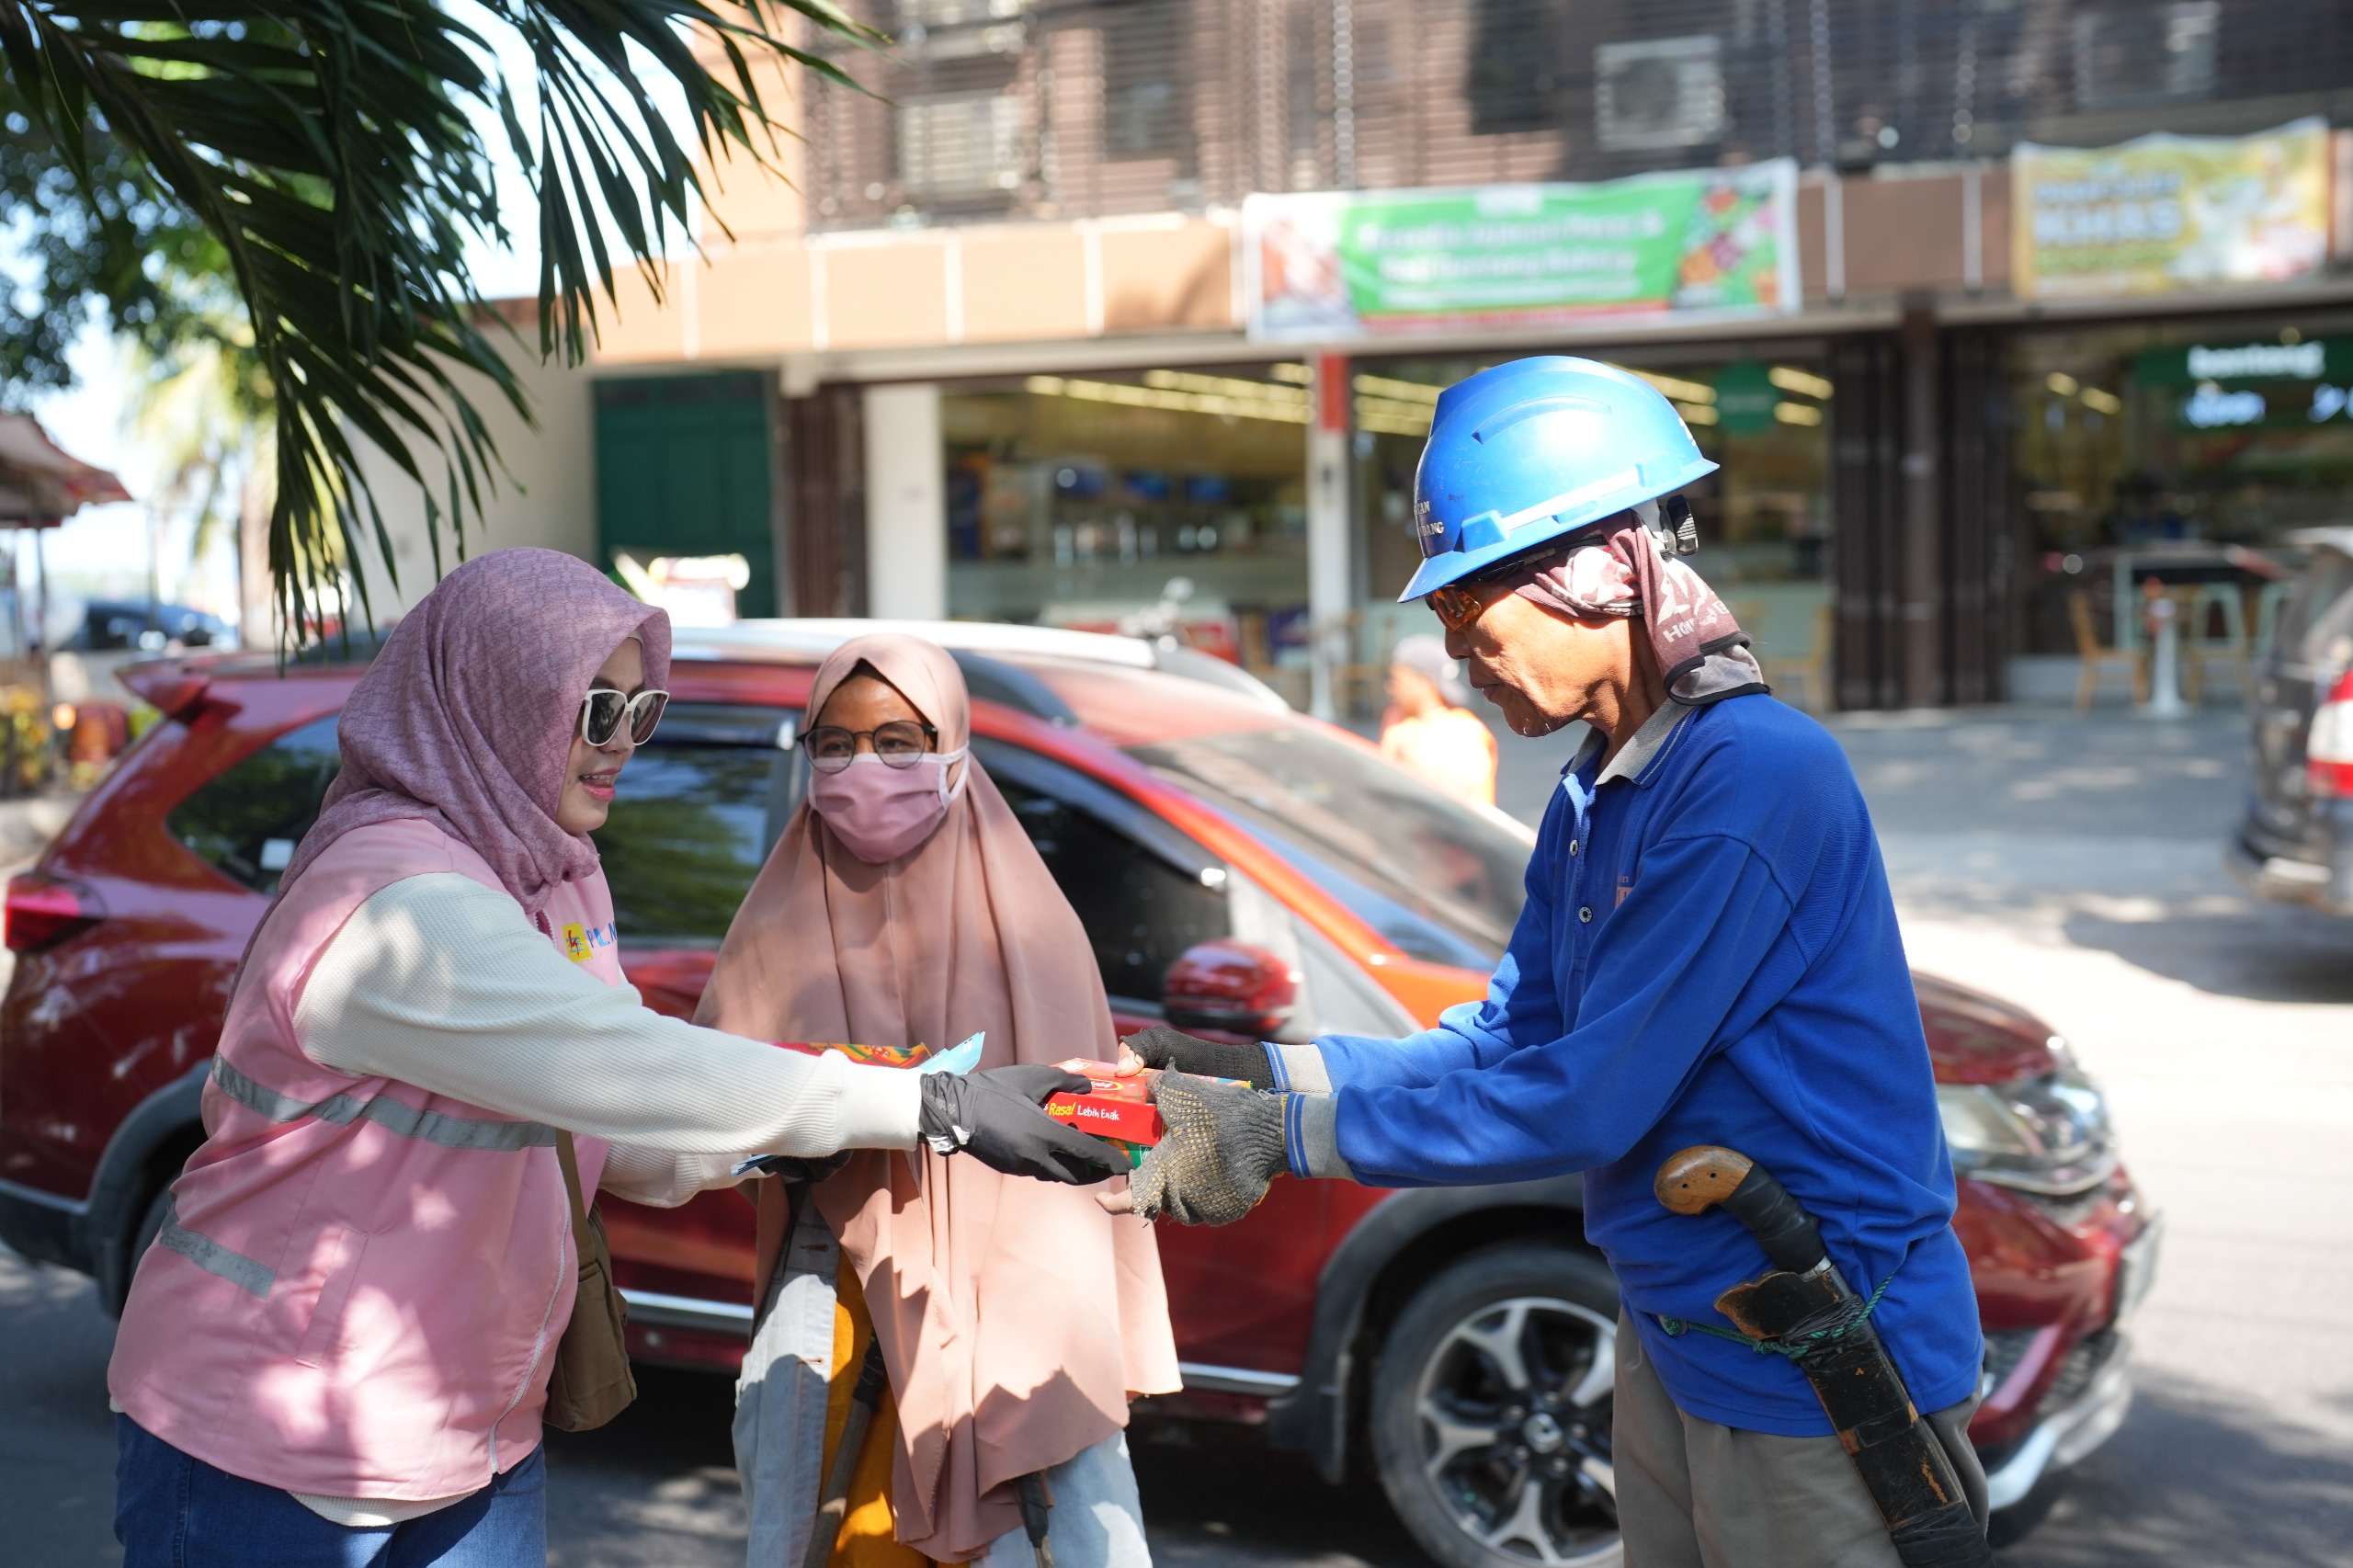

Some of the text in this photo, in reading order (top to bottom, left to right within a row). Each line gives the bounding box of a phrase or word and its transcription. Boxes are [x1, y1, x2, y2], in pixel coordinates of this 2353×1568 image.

[585, 922, 617, 948] PLN
[1077, 1105, 1099, 1118] Lebih
[1100, 1109, 1120, 1120] Enak
